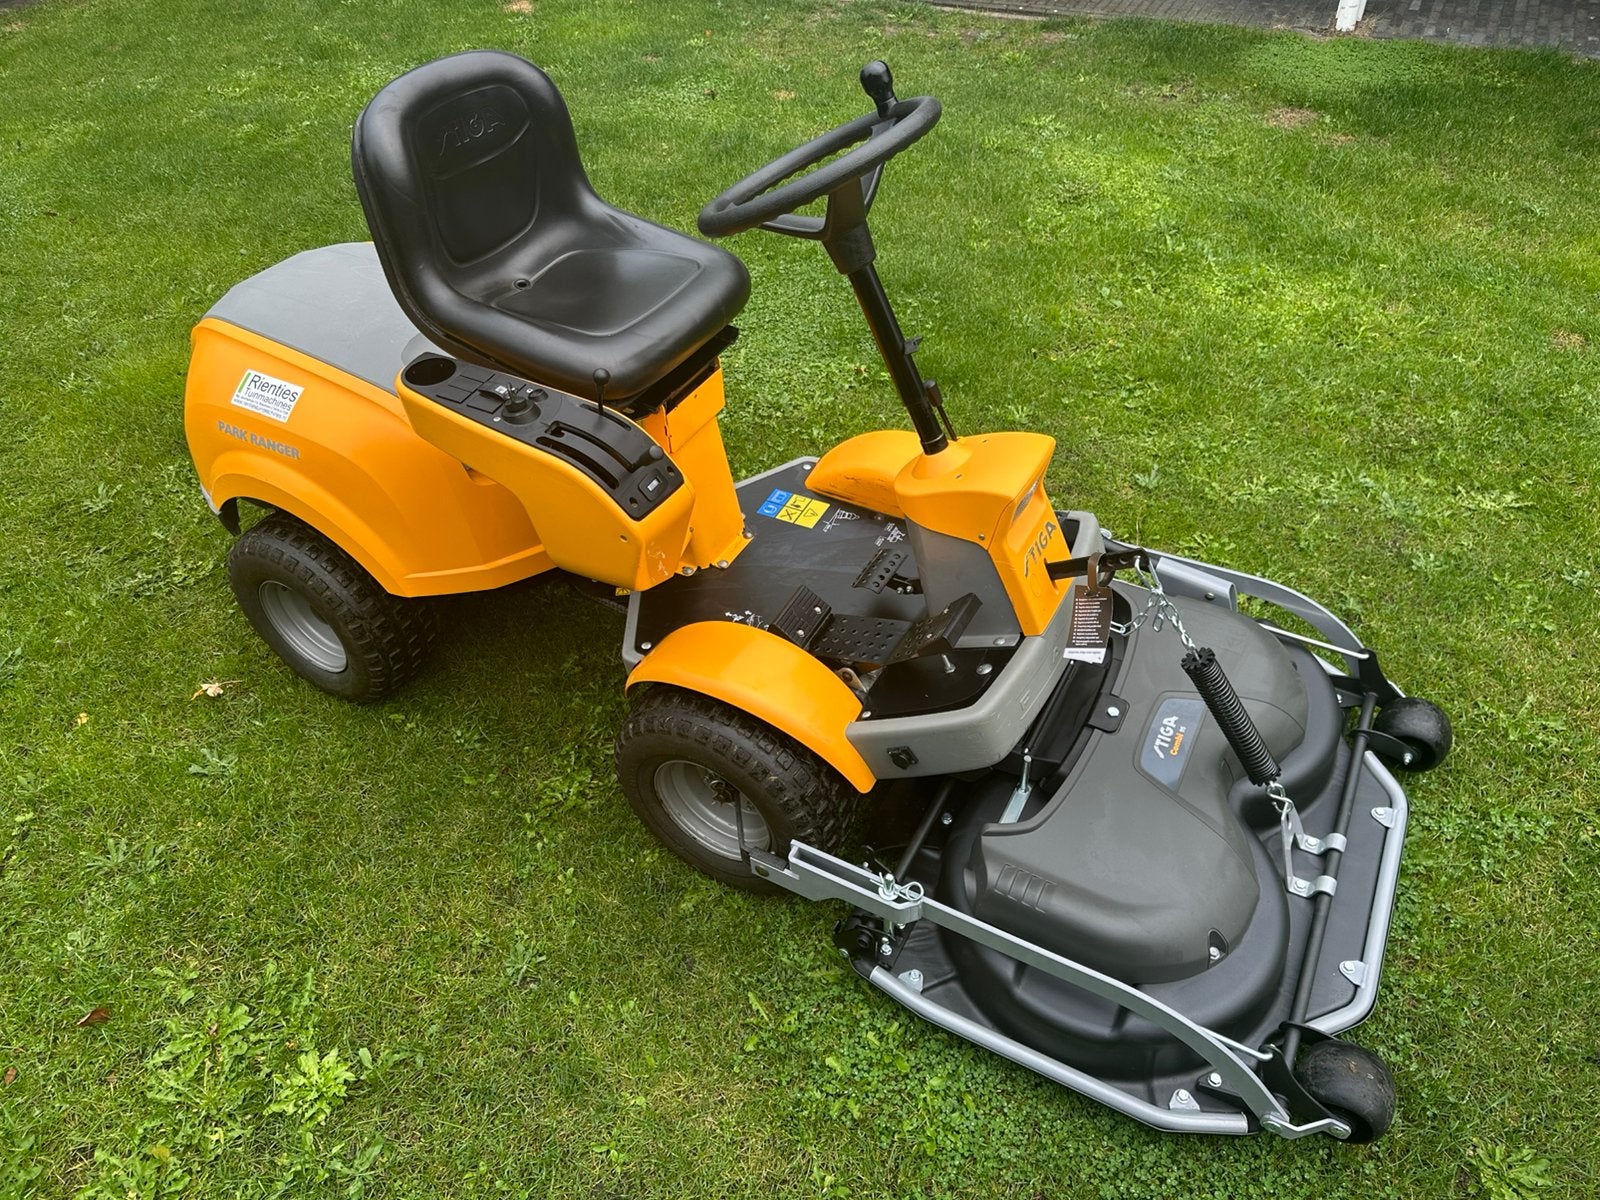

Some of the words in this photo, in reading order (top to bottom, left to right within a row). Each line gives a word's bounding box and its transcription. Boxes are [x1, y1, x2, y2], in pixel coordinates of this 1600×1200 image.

[244, 387, 292, 411] Tuinmachines
[247, 374, 299, 402] Rienties
[217, 420, 248, 441] PARK
[250, 432, 300, 460] RANGER
[1024, 521, 1057, 577] STIGA
[1153, 715, 1179, 759] STIGA
[1170, 732, 1184, 756] Combi
